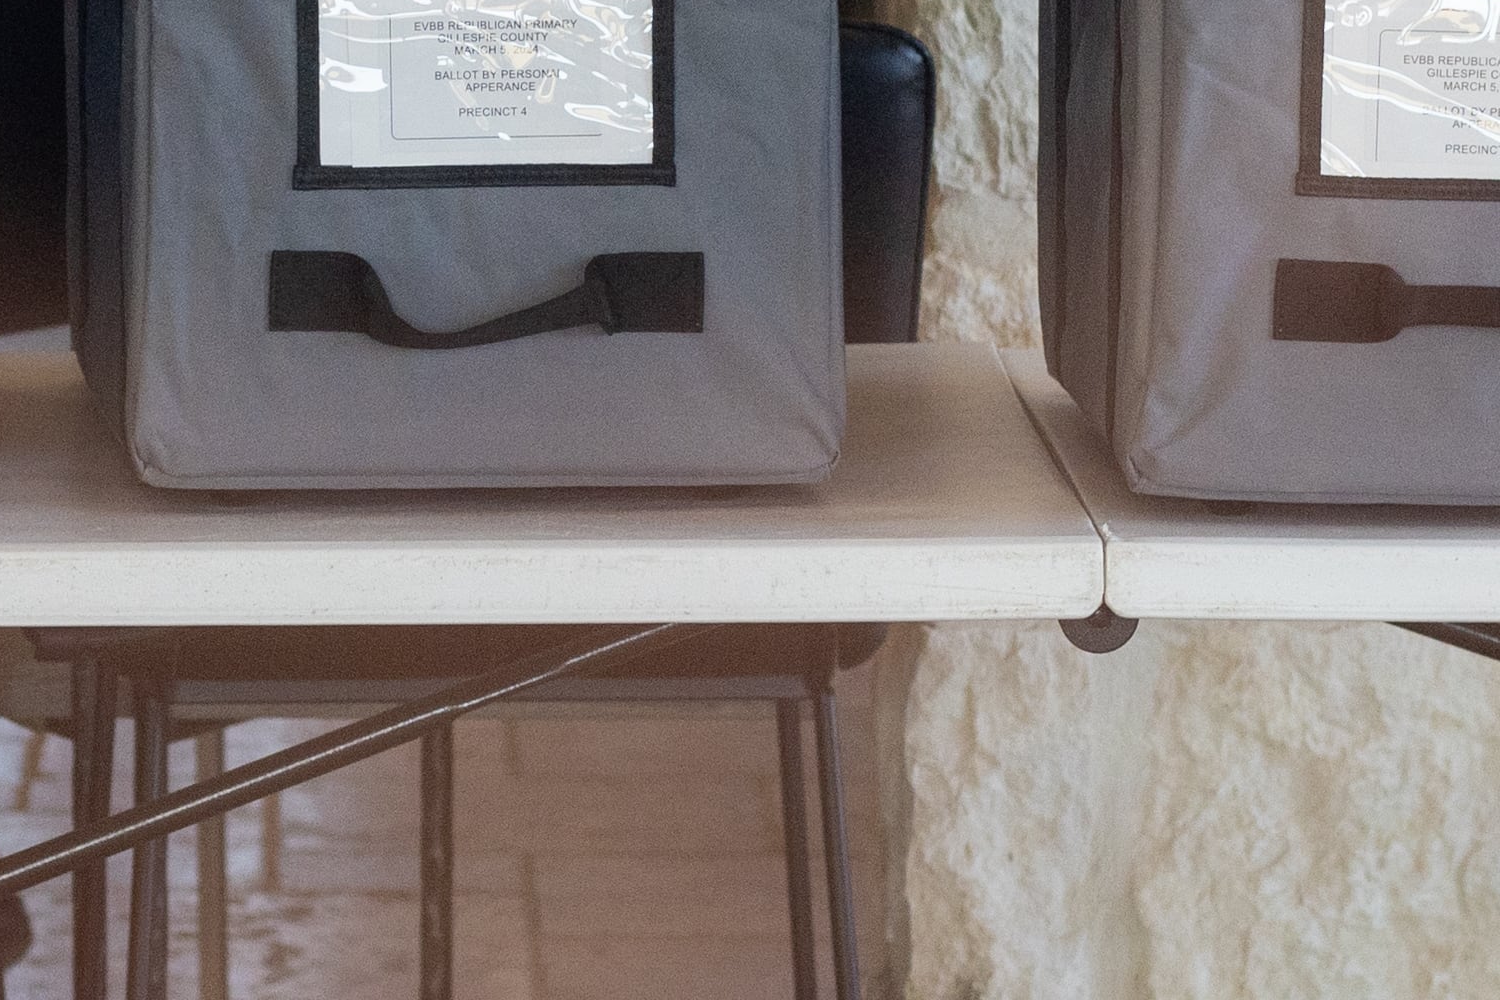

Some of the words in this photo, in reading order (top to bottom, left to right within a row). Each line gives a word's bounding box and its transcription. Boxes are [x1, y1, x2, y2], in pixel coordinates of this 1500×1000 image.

[413, 21, 445, 32] EVBB
[500, 32, 548, 42] COUNTY
[1403, 54, 1435, 65] EVBB
[434, 70, 479, 81] BALLOT
[482, 70, 497, 80] BY
[1426, 68, 1487, 79] GILLESPIE
[465, 81, 536, 92] APPERANCE
[1443, 81, 1487, 92] MARCH
[1490, 82, 1500, 93] 5,
[458, 106, 517, 118] PRECINCT
[520, 106, 527, 116] 4
